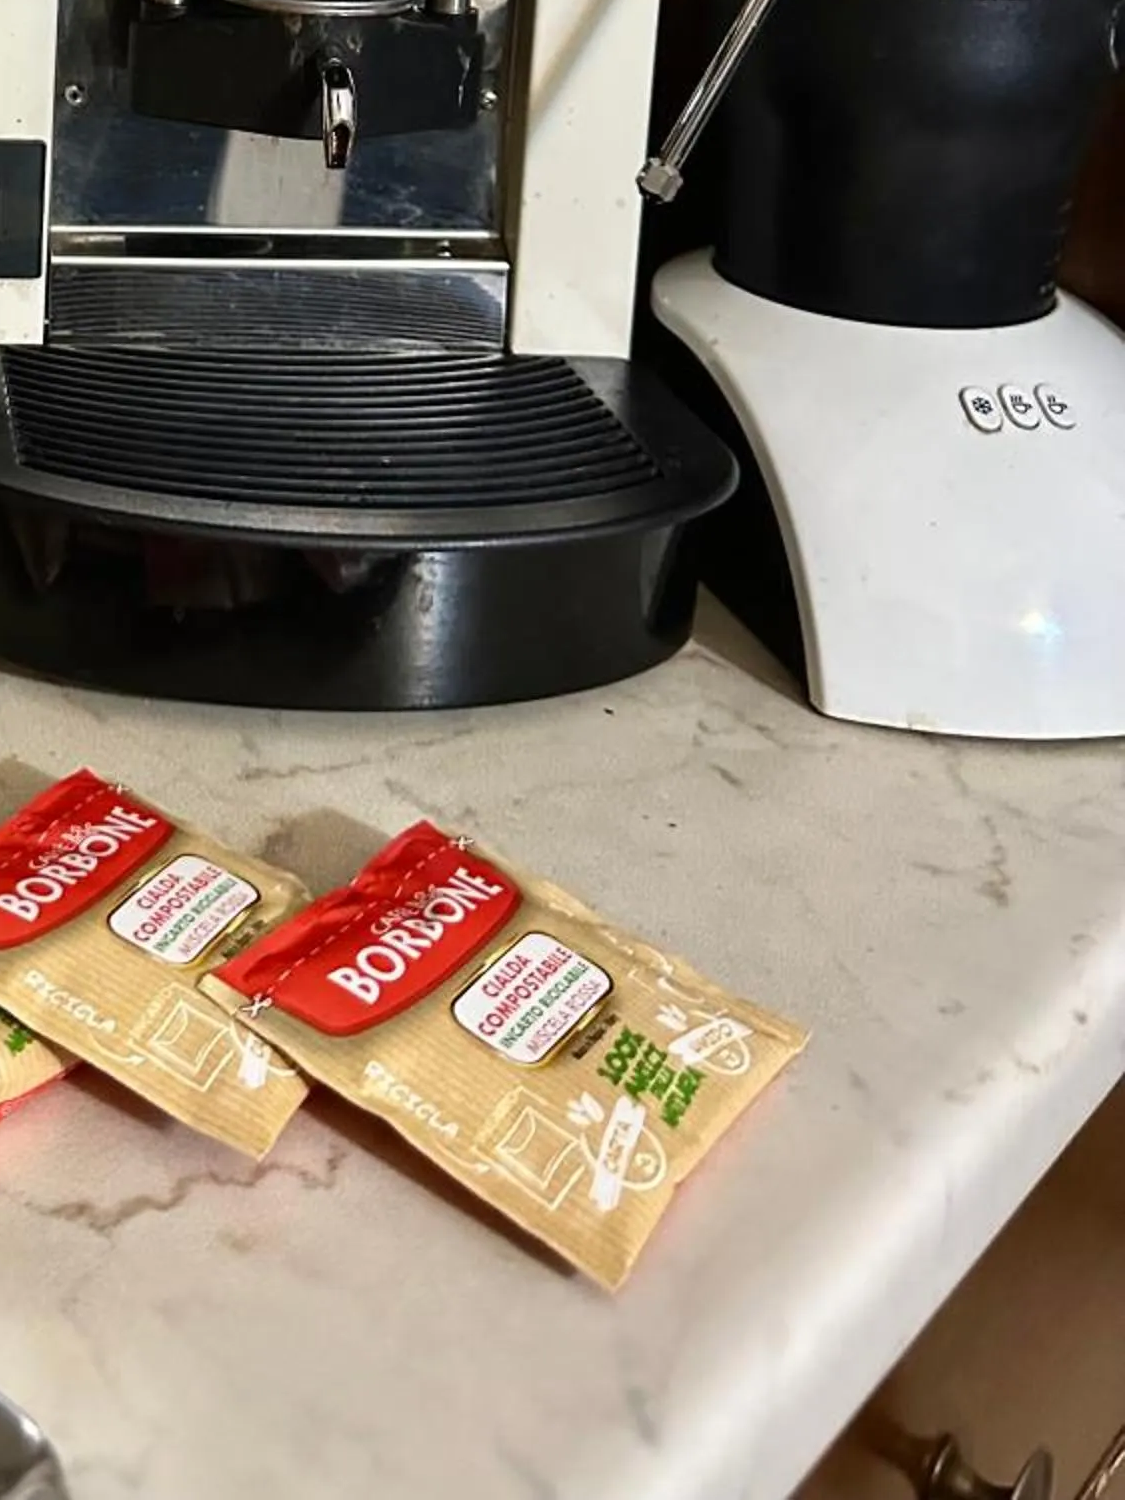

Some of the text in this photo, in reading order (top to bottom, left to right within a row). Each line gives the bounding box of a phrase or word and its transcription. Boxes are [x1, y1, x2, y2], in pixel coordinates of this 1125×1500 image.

[133, 866, 222, 942] COMPOSTABILE
[136, 873, 183, 909] CIALDA
[151, 911, 196, 952] INCARTO
[327, 866, 504, 1005] BORBONE
[25, 970, 117, 1034] RICICLA
[477, 947, 572, 1036] COMPOSTABILE
[481, 954, 533, 998] CIALDA
[499, 960, 589, 1049] INCARTO RICICLABILE
[523, 1009, 572, 1054] MISCELA
[604, 1120, 632, 1174] CARTA
